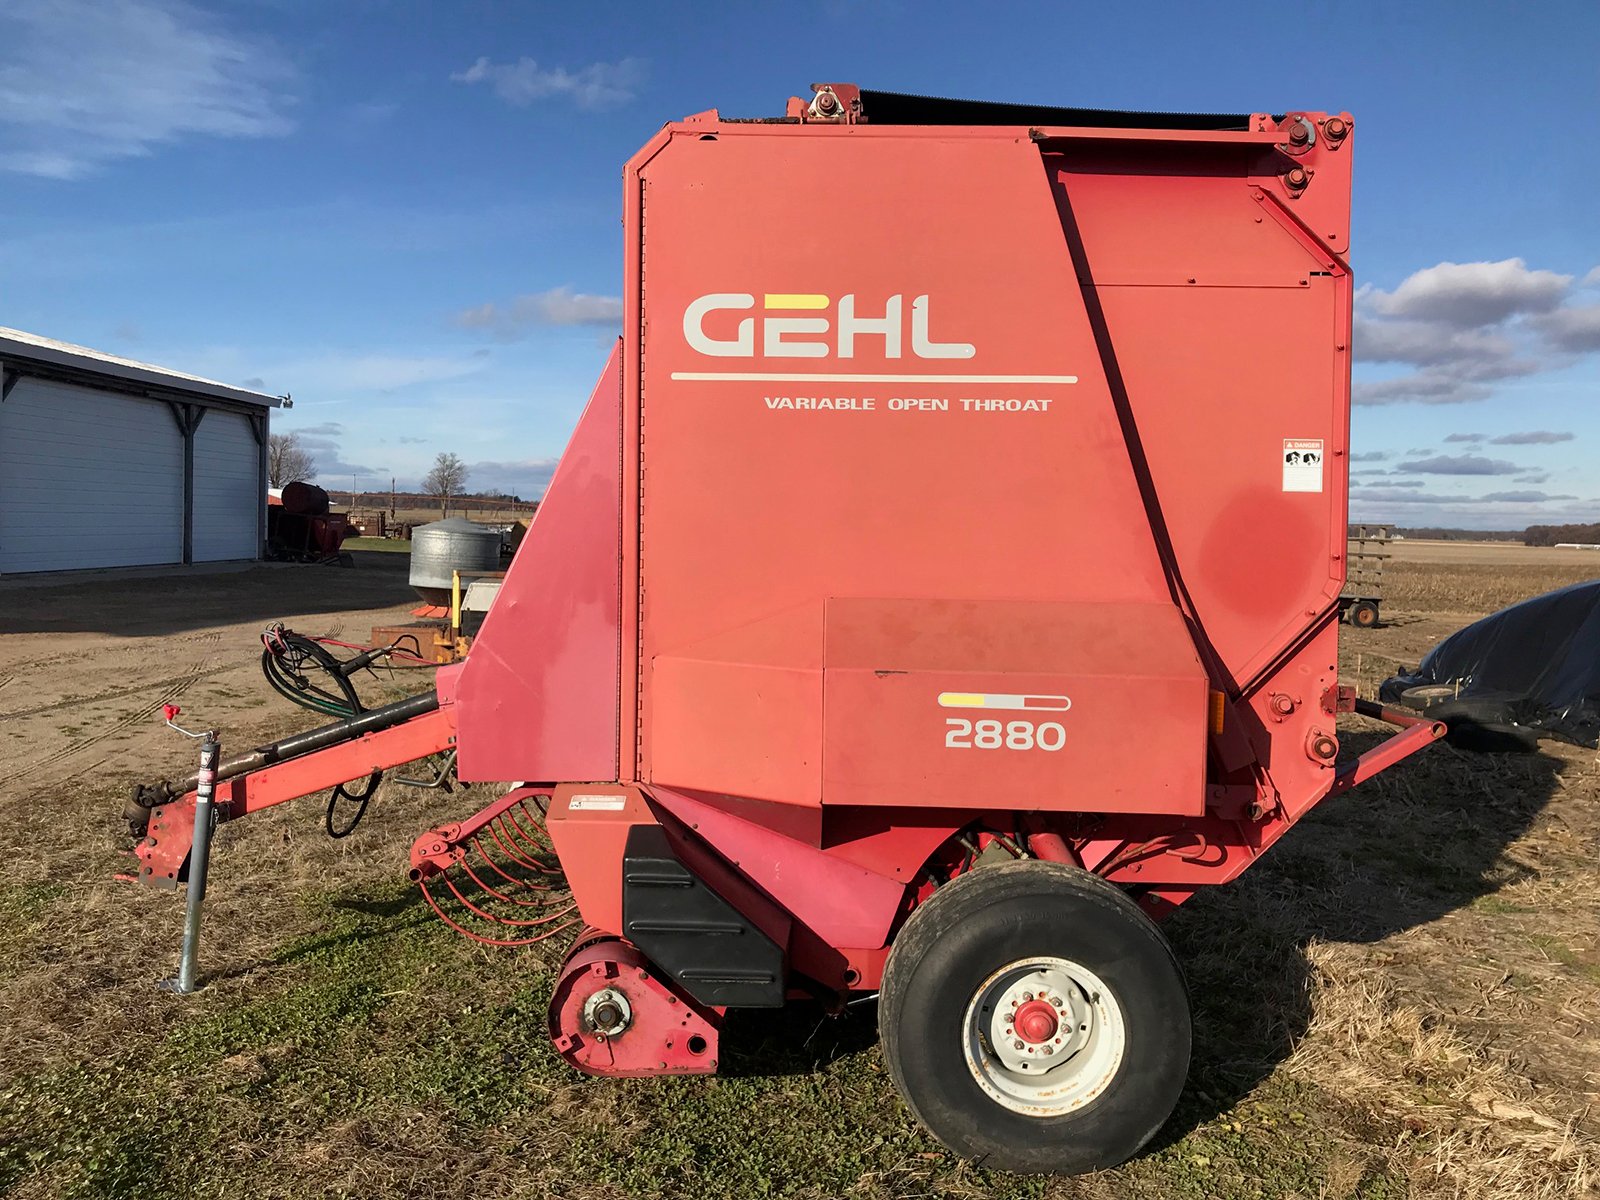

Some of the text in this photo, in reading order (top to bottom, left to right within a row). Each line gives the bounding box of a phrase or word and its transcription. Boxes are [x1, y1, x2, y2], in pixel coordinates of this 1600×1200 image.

[683, 294, 976, 358] GEHL
[765, 398, 1051, 412] VARIABLE OPEN THROAT
[946, 718, 1066, 751] 2880
